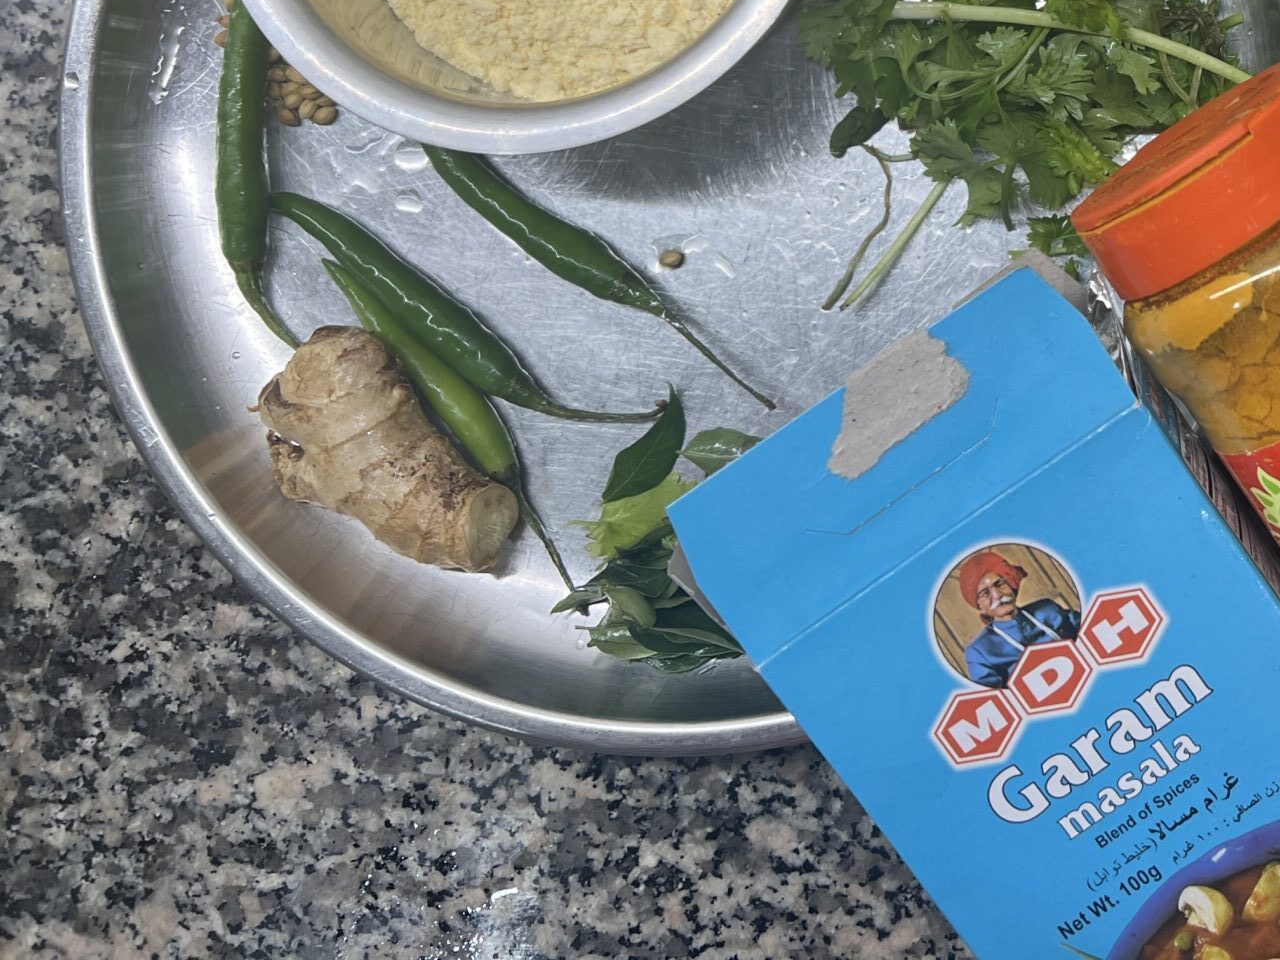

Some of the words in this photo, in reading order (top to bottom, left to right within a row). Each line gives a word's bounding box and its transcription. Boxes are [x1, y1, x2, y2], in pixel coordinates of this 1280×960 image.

[949, 600, 1150, 754] MDH
[987, 663, 1214, 824] Garam
[1056, 733, 1201, 841] masala
[1095, 817, 1137, 849] Blend
[1139, 803, 1154, 820] of
[1153, 773, 1200, 809] Spices
[1057, 915, 1091, 940] Net
[1087, 896, 1120, 918] Wt.
[1119, 864, 1163, 897] 100g
